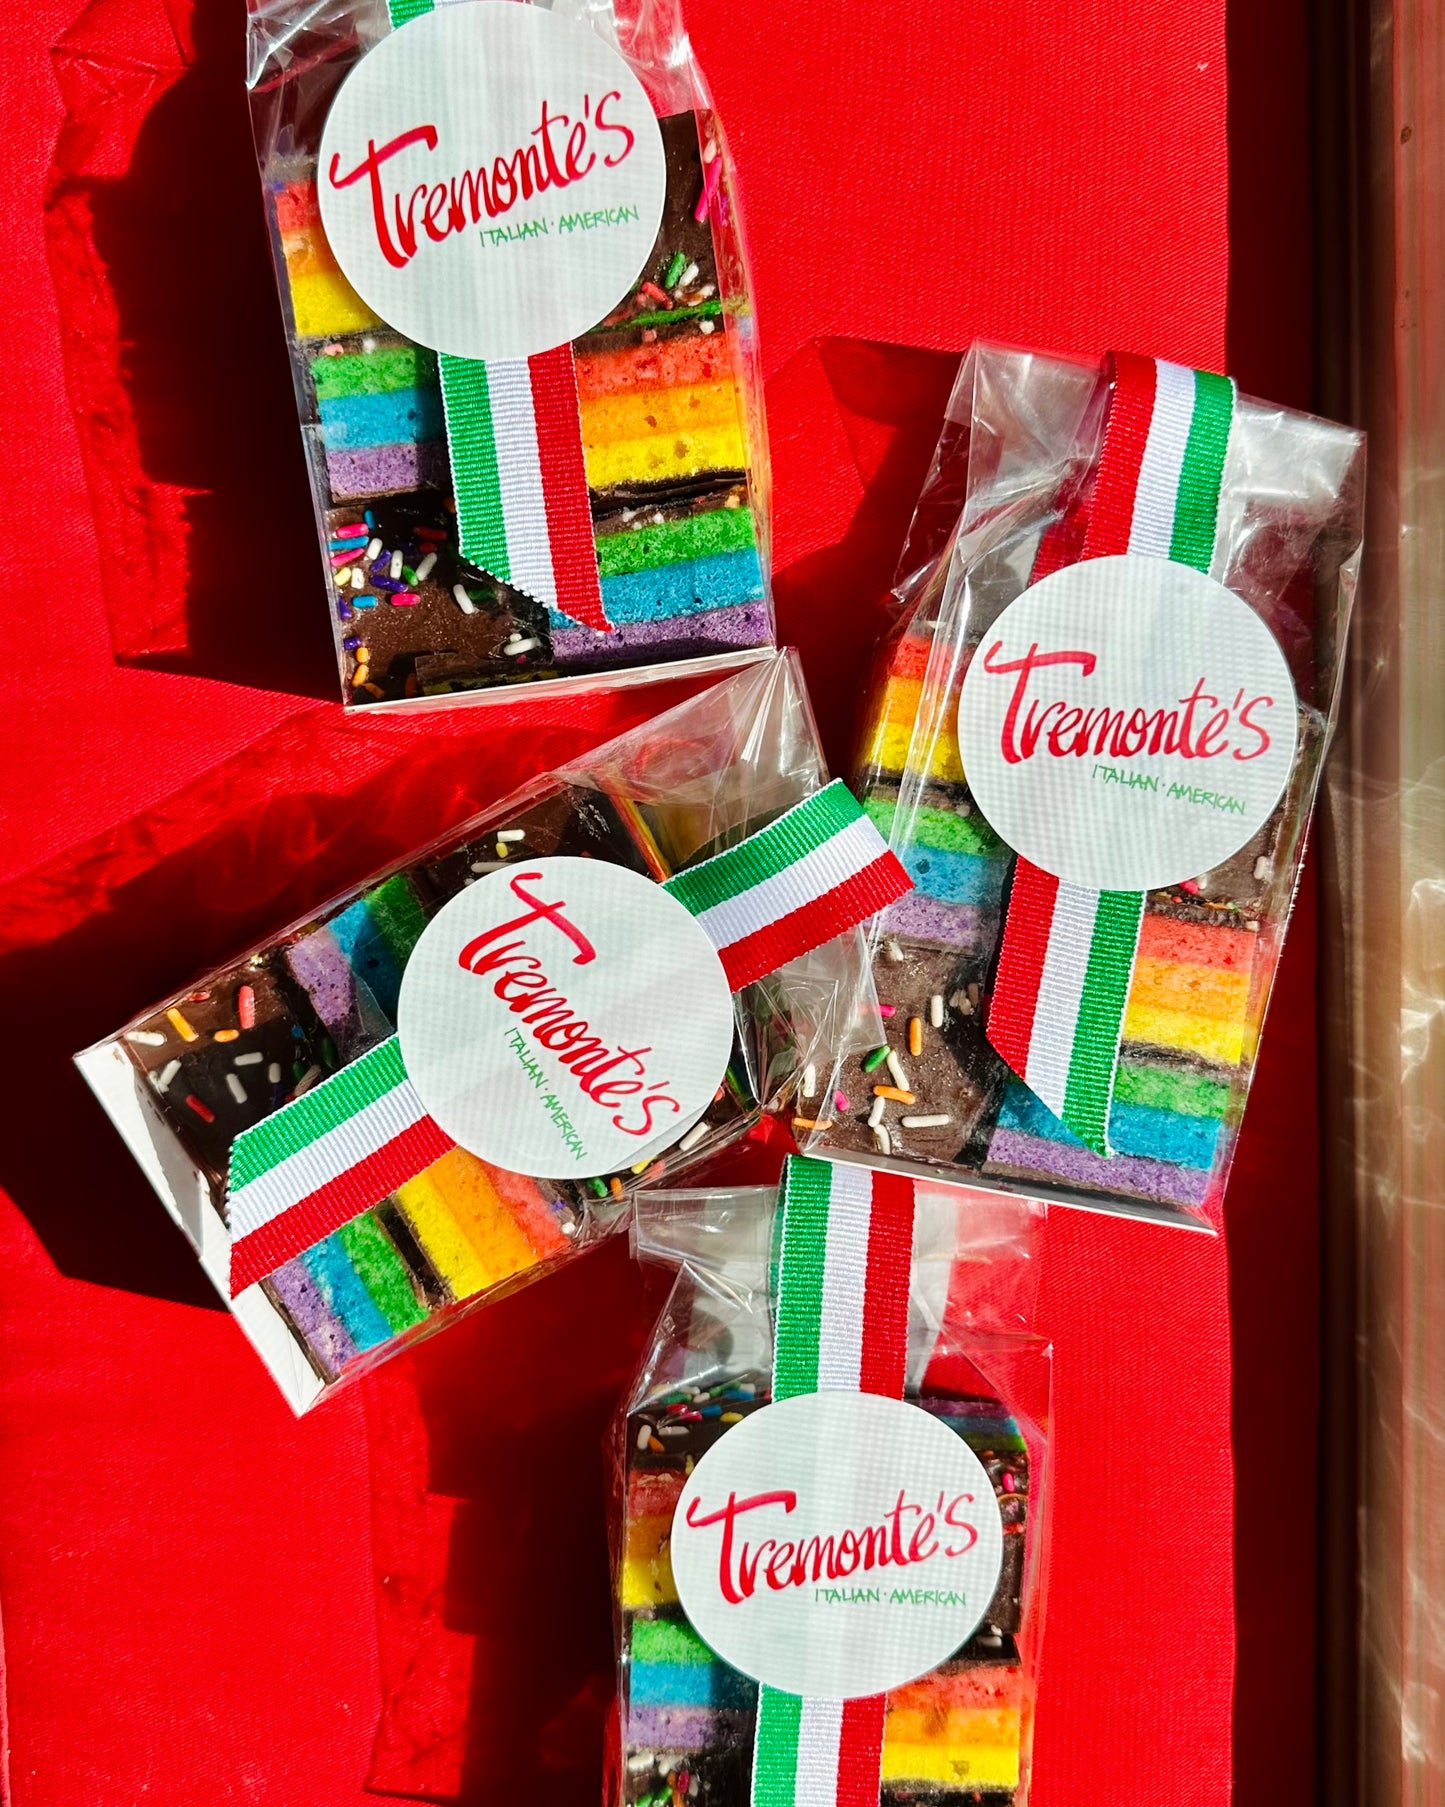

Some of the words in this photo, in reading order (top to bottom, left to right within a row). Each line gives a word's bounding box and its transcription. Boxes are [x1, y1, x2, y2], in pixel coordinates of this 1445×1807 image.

[479, 217, 549, 248] ITALIAN
[558, 205, 640, 234] AMERICAN
[1092, 763, 1160, 793] ITALIAN
[1166, 782, 1246, 816] AMERICAN
[503, 1026, 549, 1090] ITALIAN
[539, 1093, 588, 1161] AMERICAN
[815, 1587, 881, 1604] ITALIAN
[888, 1588, 967, 1606] AMERICAN
